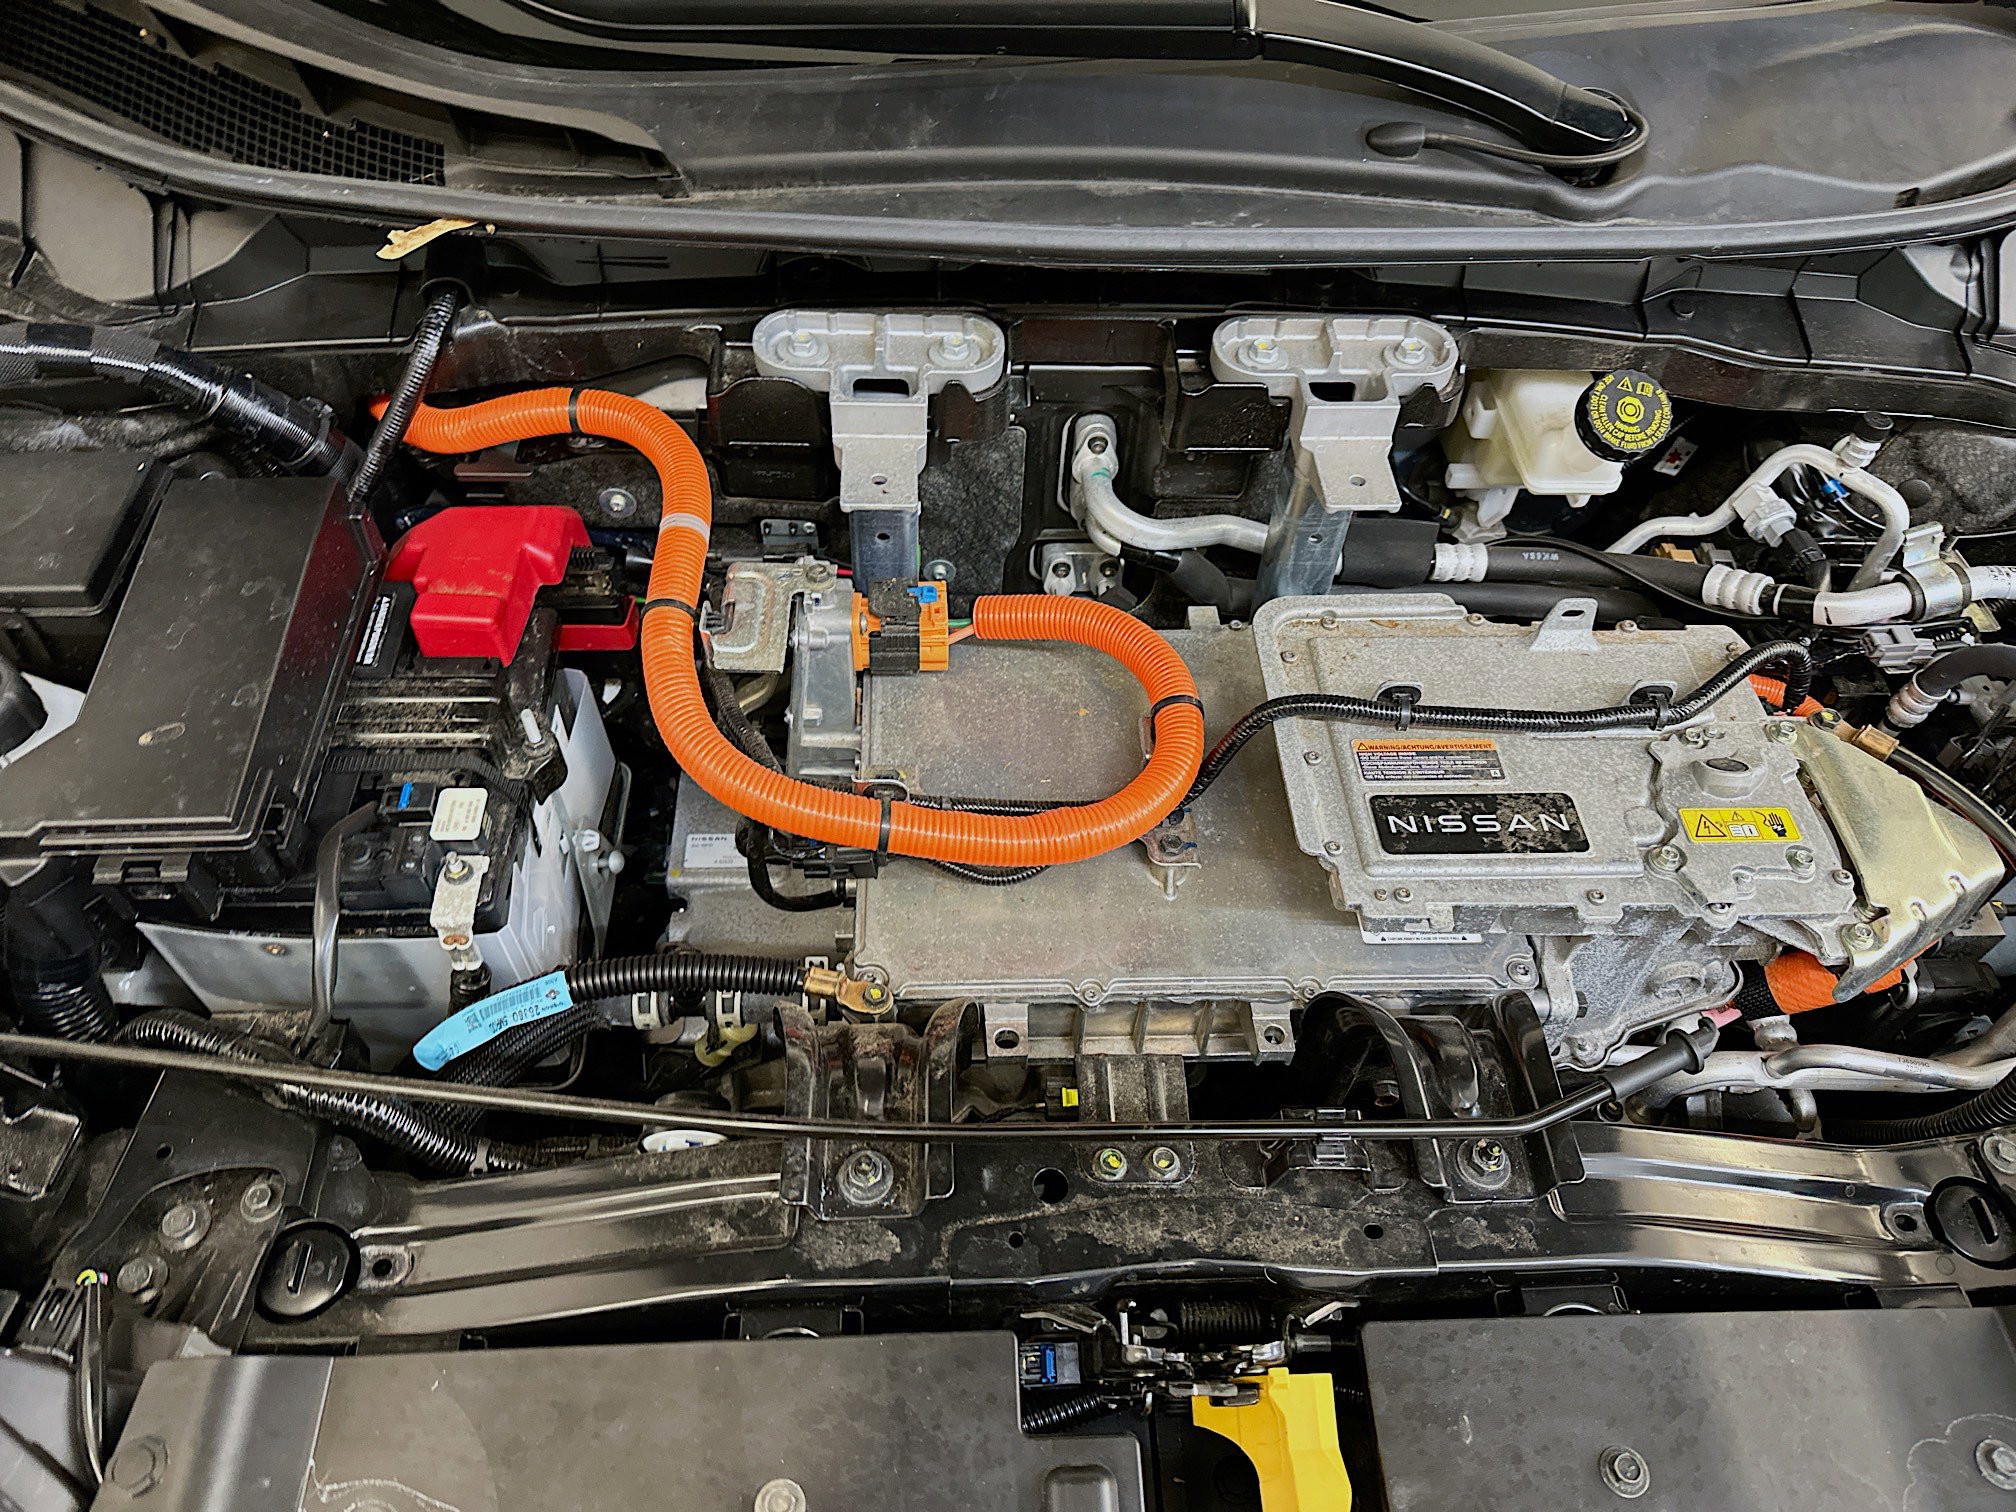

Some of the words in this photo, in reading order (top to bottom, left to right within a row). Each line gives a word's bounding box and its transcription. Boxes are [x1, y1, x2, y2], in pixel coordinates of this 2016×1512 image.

[1599, 394, 1608, 413] CLEAN
[1656, 388, 1671, 419] CONTAINER
[1600, 412, 1615, 433] FILLER
[1613, 420, 1640, 433] WARNING
[1645, 409, 1662, 436] REMOVING
[1654, 418, 1669, 438] SEALED
[1602, 431, 1621, 447] BRAKE
[1611, 428, 1625, 439] CAP
[1624, 431, 1648, 442] BEFORE
[1620, 440, 1638, 449] FLUID
[1637, 437, 1653, 448] FROM
[1387, 813, 1571, 833] NISSAN
